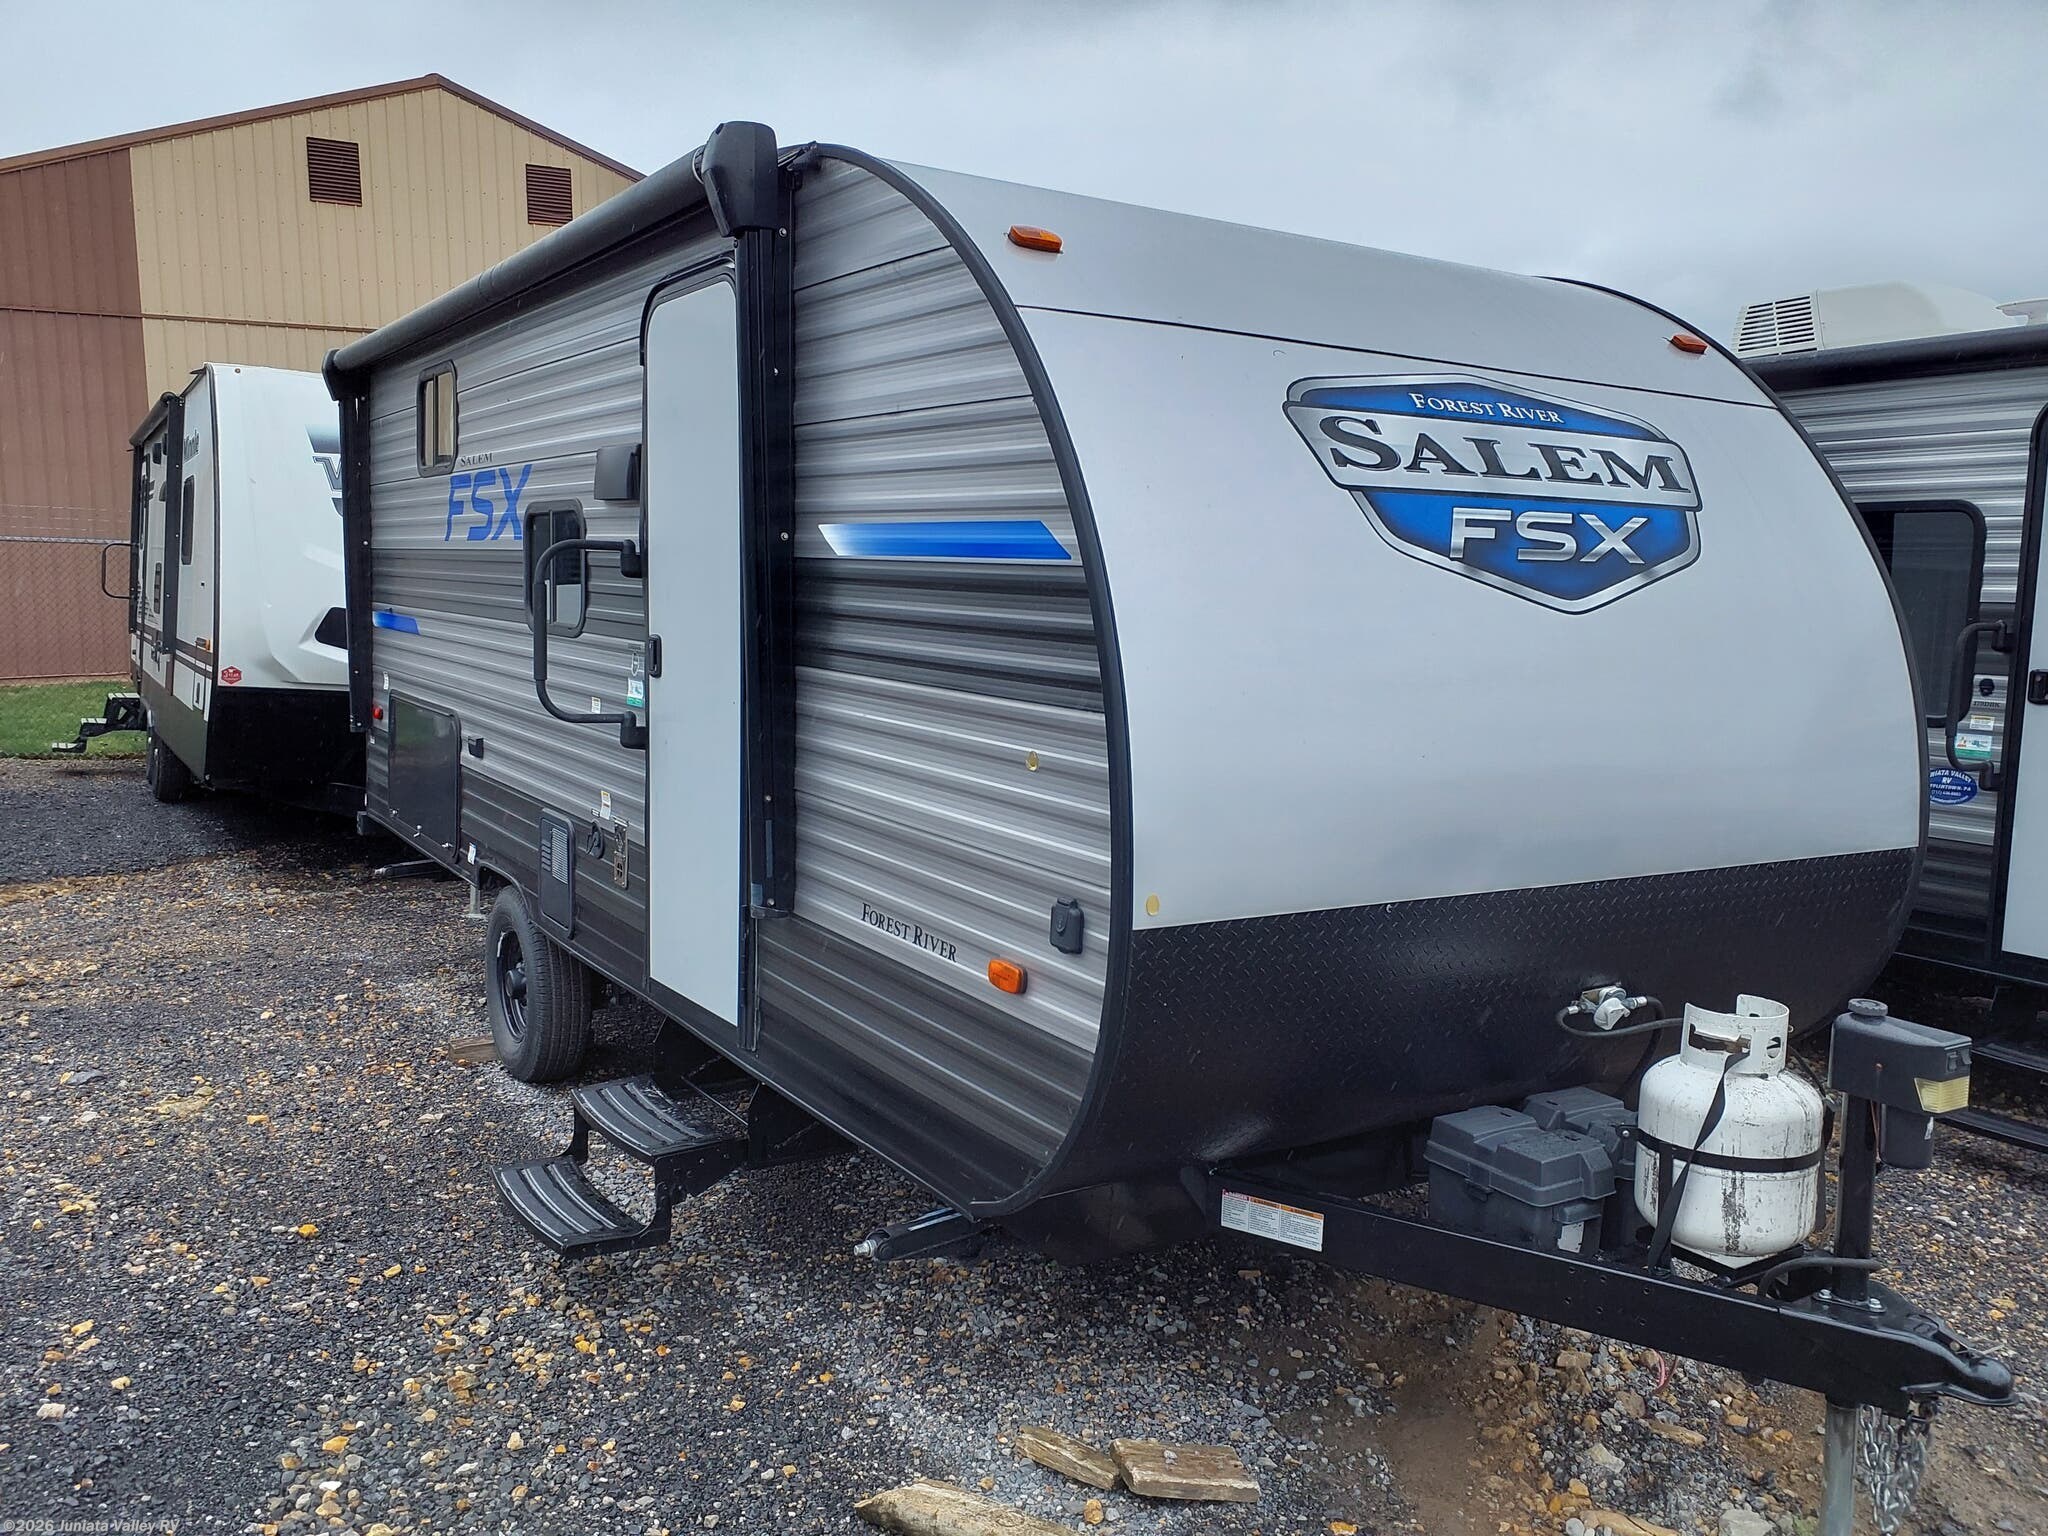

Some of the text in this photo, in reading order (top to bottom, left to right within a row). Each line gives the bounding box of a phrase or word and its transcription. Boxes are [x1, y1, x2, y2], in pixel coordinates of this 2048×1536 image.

[1408, 392, 1565, 424] FOREST RIVER
[460, 452, 494, 467] SALEM
[1319, 415, 1691, 494] SALEM
[444, 463, 533, 542] FSX
[1448, 507, 1650, 565] FSX
[1942, 776, 1953, 785] RV
[861, 902, 958, 963] FOREST RIVER
